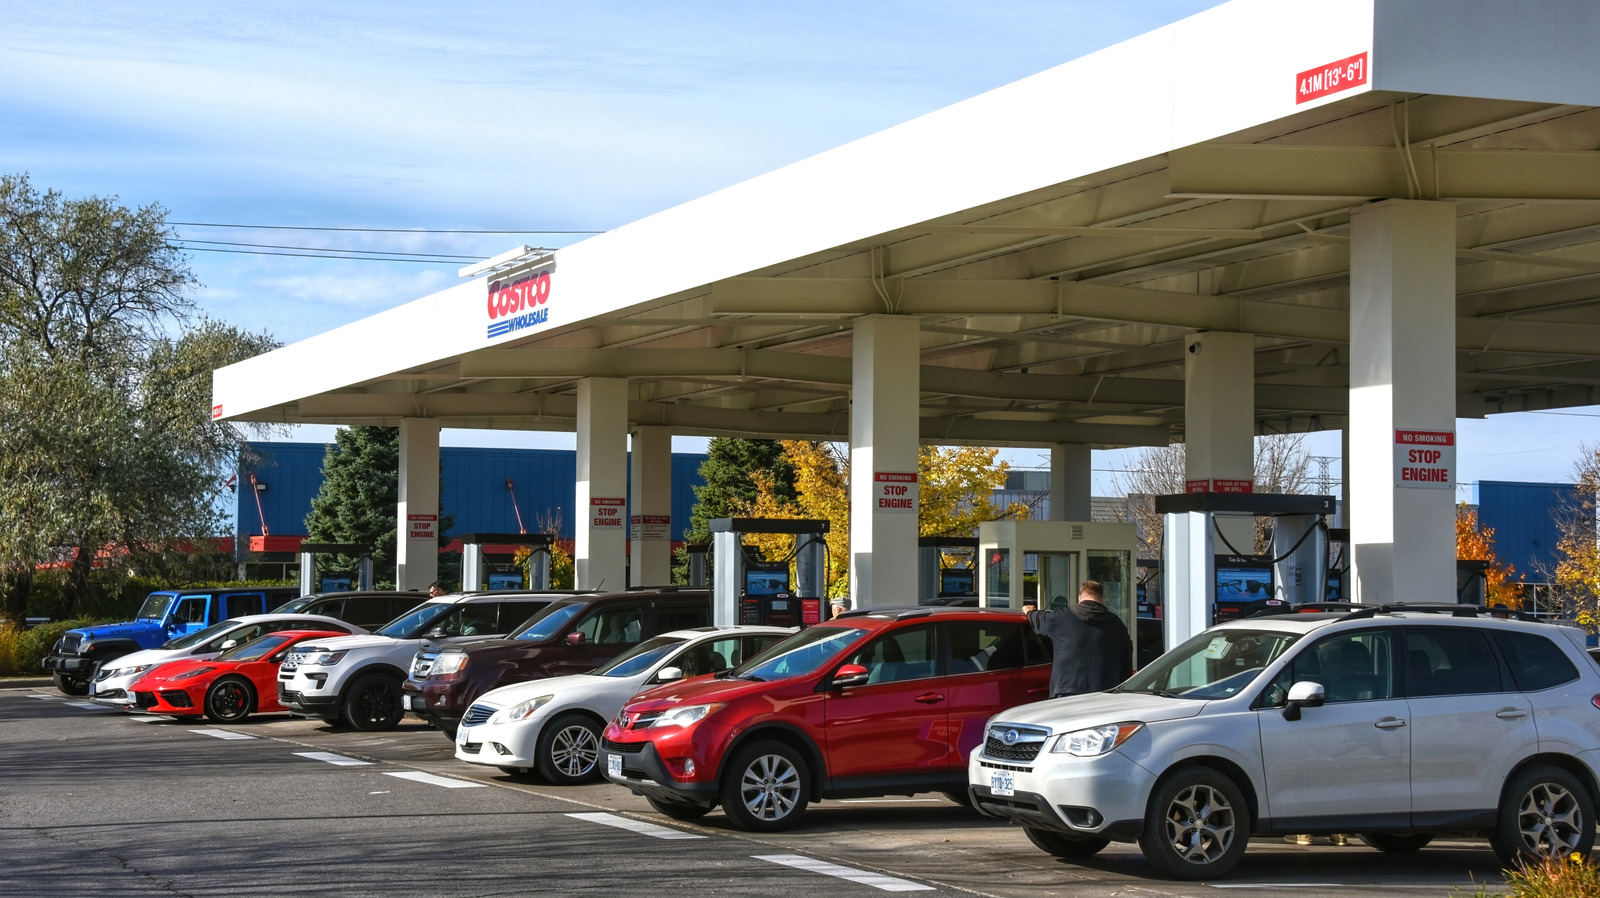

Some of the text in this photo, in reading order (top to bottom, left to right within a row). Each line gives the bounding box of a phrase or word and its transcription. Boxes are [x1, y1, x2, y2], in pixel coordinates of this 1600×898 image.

[1300, 73, 1322, 95] 4.1M
[487, 269, 551, 320] COSTCO
[508, 307, 549, 333] WHOLESALE
[1402, 433, 1447, 443] NO SMOKING
[1408, 449, 1441, 464] STOP
[1401, 467, 1448, 483] ENGINE
[883, 485, 908, 496] STOP
[878, 498, 913, 509] ENGINE
[1324, 500, 1329, 508] 3
[597, 507, 618, 516] STOP
[413, 522, 431, 530] STOP
[594, 517, 622, 526] ENGINE
[410, 530, 434, 538] ENGINE
